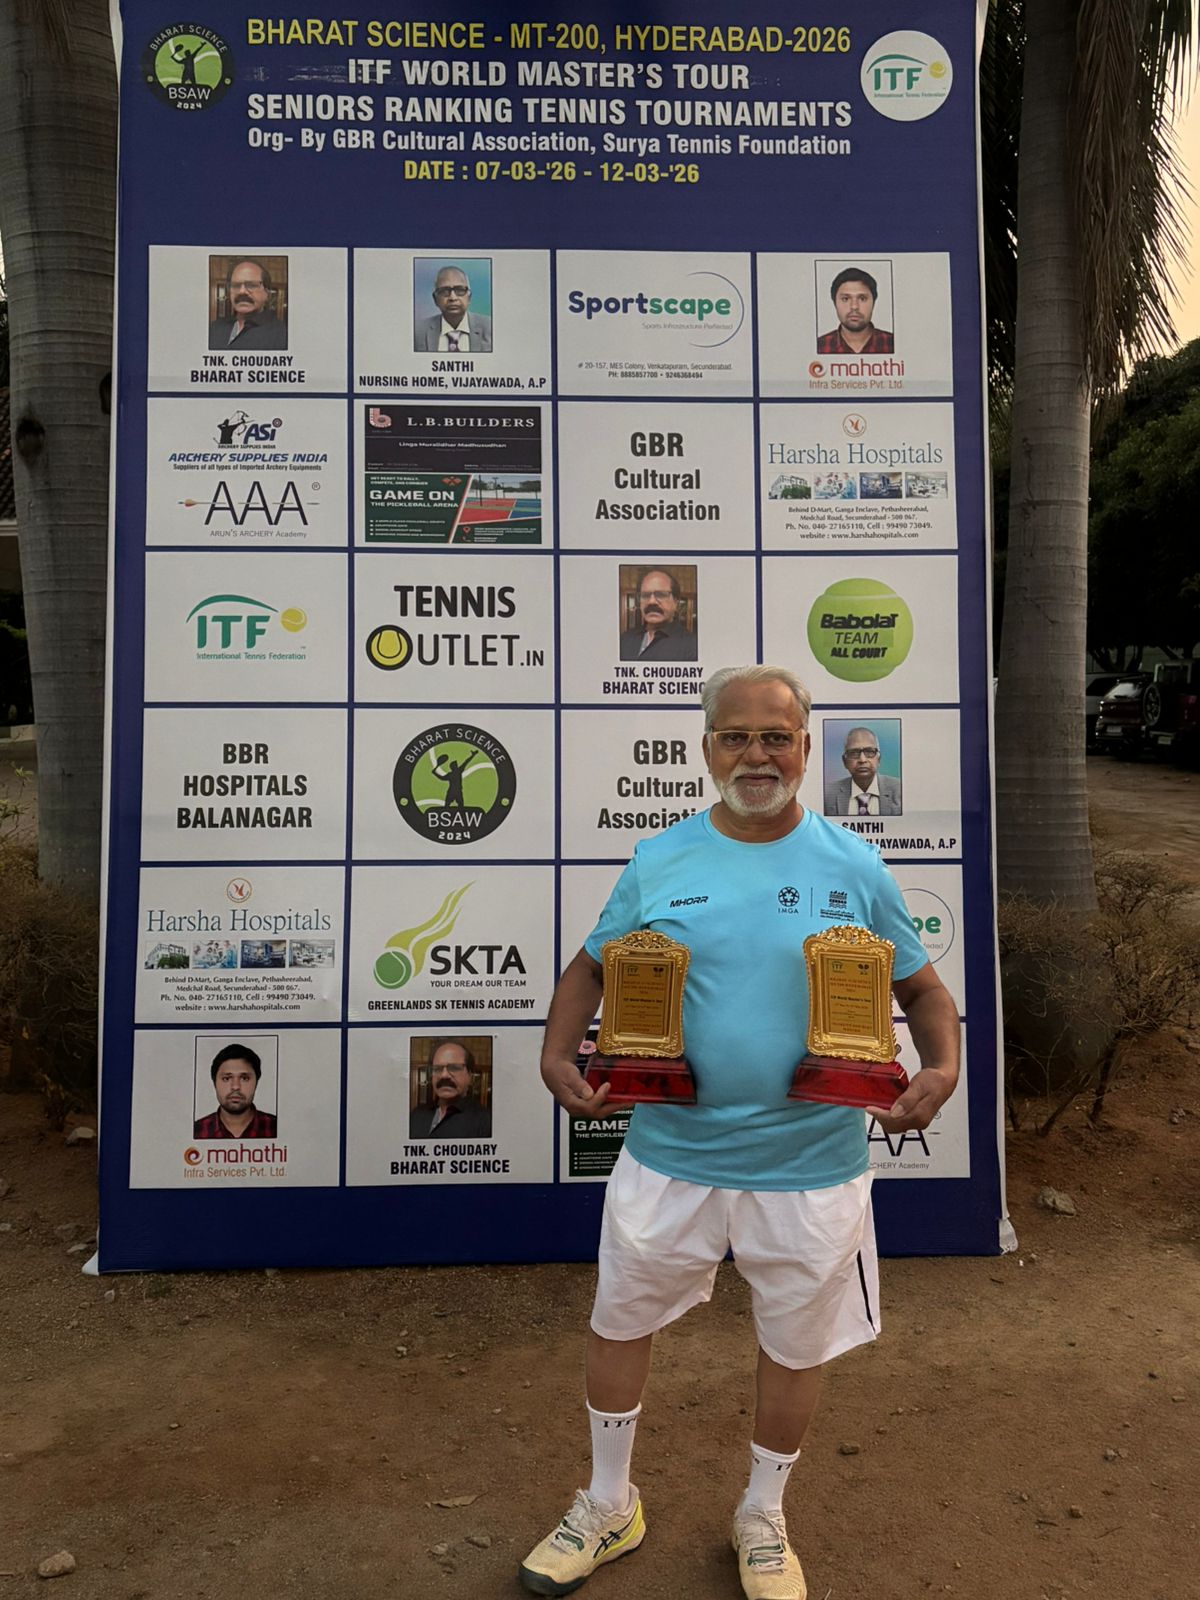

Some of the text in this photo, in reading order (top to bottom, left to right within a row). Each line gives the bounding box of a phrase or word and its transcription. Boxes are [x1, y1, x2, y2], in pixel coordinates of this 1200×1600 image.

[150, 25, 228, 52] BHARAT SCIENCE
[247, 19, 851, 54] BHARAT SCIENCE MT-200, HYDERABAD-2026
[348, 59, 750, 89] ITF WORLD MASTER’S TOUR
[874, 68, 922, 90] ITF
[169, 87, 211, 100] BSAW
[248, 94, 851, 127] SENIORS RANKING TENNIS TOURNAMENTS
[248, 128, 851, 156] Org- By GBR Cultural Association, Surya Tennis Foundation
[404, 161, 454, 180] DATE
[568, 290, 731, 321] Sportscape
[203, 356, 293, 366] TNK. CHOUDARY
[432, 361, 474, 372] SANTHI
[830, 358, 905, 376] mahathi
[191, 370, 305, 383] BHARAT SCIENCE
[359, 376, 546, 389] NURSING HOME, VIJAYAWADA, A.P
[809, 380, 828, 389] Infra
[831, 380, 868, 389] Services
[630, 432, 684, 457] GBR
[169, 453, 328, 462] ARCHERY SUPPLIES INDIA
[768, 442, 943, 467] Harsha Hospitals
[614, 468, 701, 490] Cultural
[204, 481, 308, 525] AAA
[370, 490, 454, 500] GAME ON
[595, 499, 720, 520] Association
[394, 585, 516, 618] TENNIS
[197, 615, 271, 648] ITF
[835, 632, 879, 644] TEAM
[197, 652, 241, 660] International
[831, 647, 887, 658] ALL COURT
[614, 667, 703, 678] TNK. CHOUDARY
[603, 682, 706, 694] BHARAT SCIENC
[223, 743, 269, 764] BBR
[404, 729, 506, 764] BHARAT SCIENCE
[634, 740, 687, 765] GBR
[184, 775, 307, 796] HOSPITALS
[617, 777, 703, 797] Cultural
[177, 807, 312, 828] BALANAGAR
[428, 812, 483, 828] BSAW
[597, 808, 696, 828] Associat
[438, 832, 471, 840] 2024
[938, 838, 956, 848] A.P
[670, 896, 708, 908] MHORR
[146, 909, 331, 934] Harsha Hospitals
[430, 945, 526, 975] SKTA
[234, 976, 260, 984] Enclave,
[368, 999, 535, 1010] GREENLANDS SK TENNIS ACADEMY
[574, 1120, 629, 1131] GAME
[207, 1143, 287, 1163] mahathi
[403, 1144, 497, 1157] TNK. CHOUDARY
[184, 1168, 204, 1178] Infra
[207, 1168, 247, 1177] Services
[391, 1160, 510, 1175] BHARAT SCIENCE
